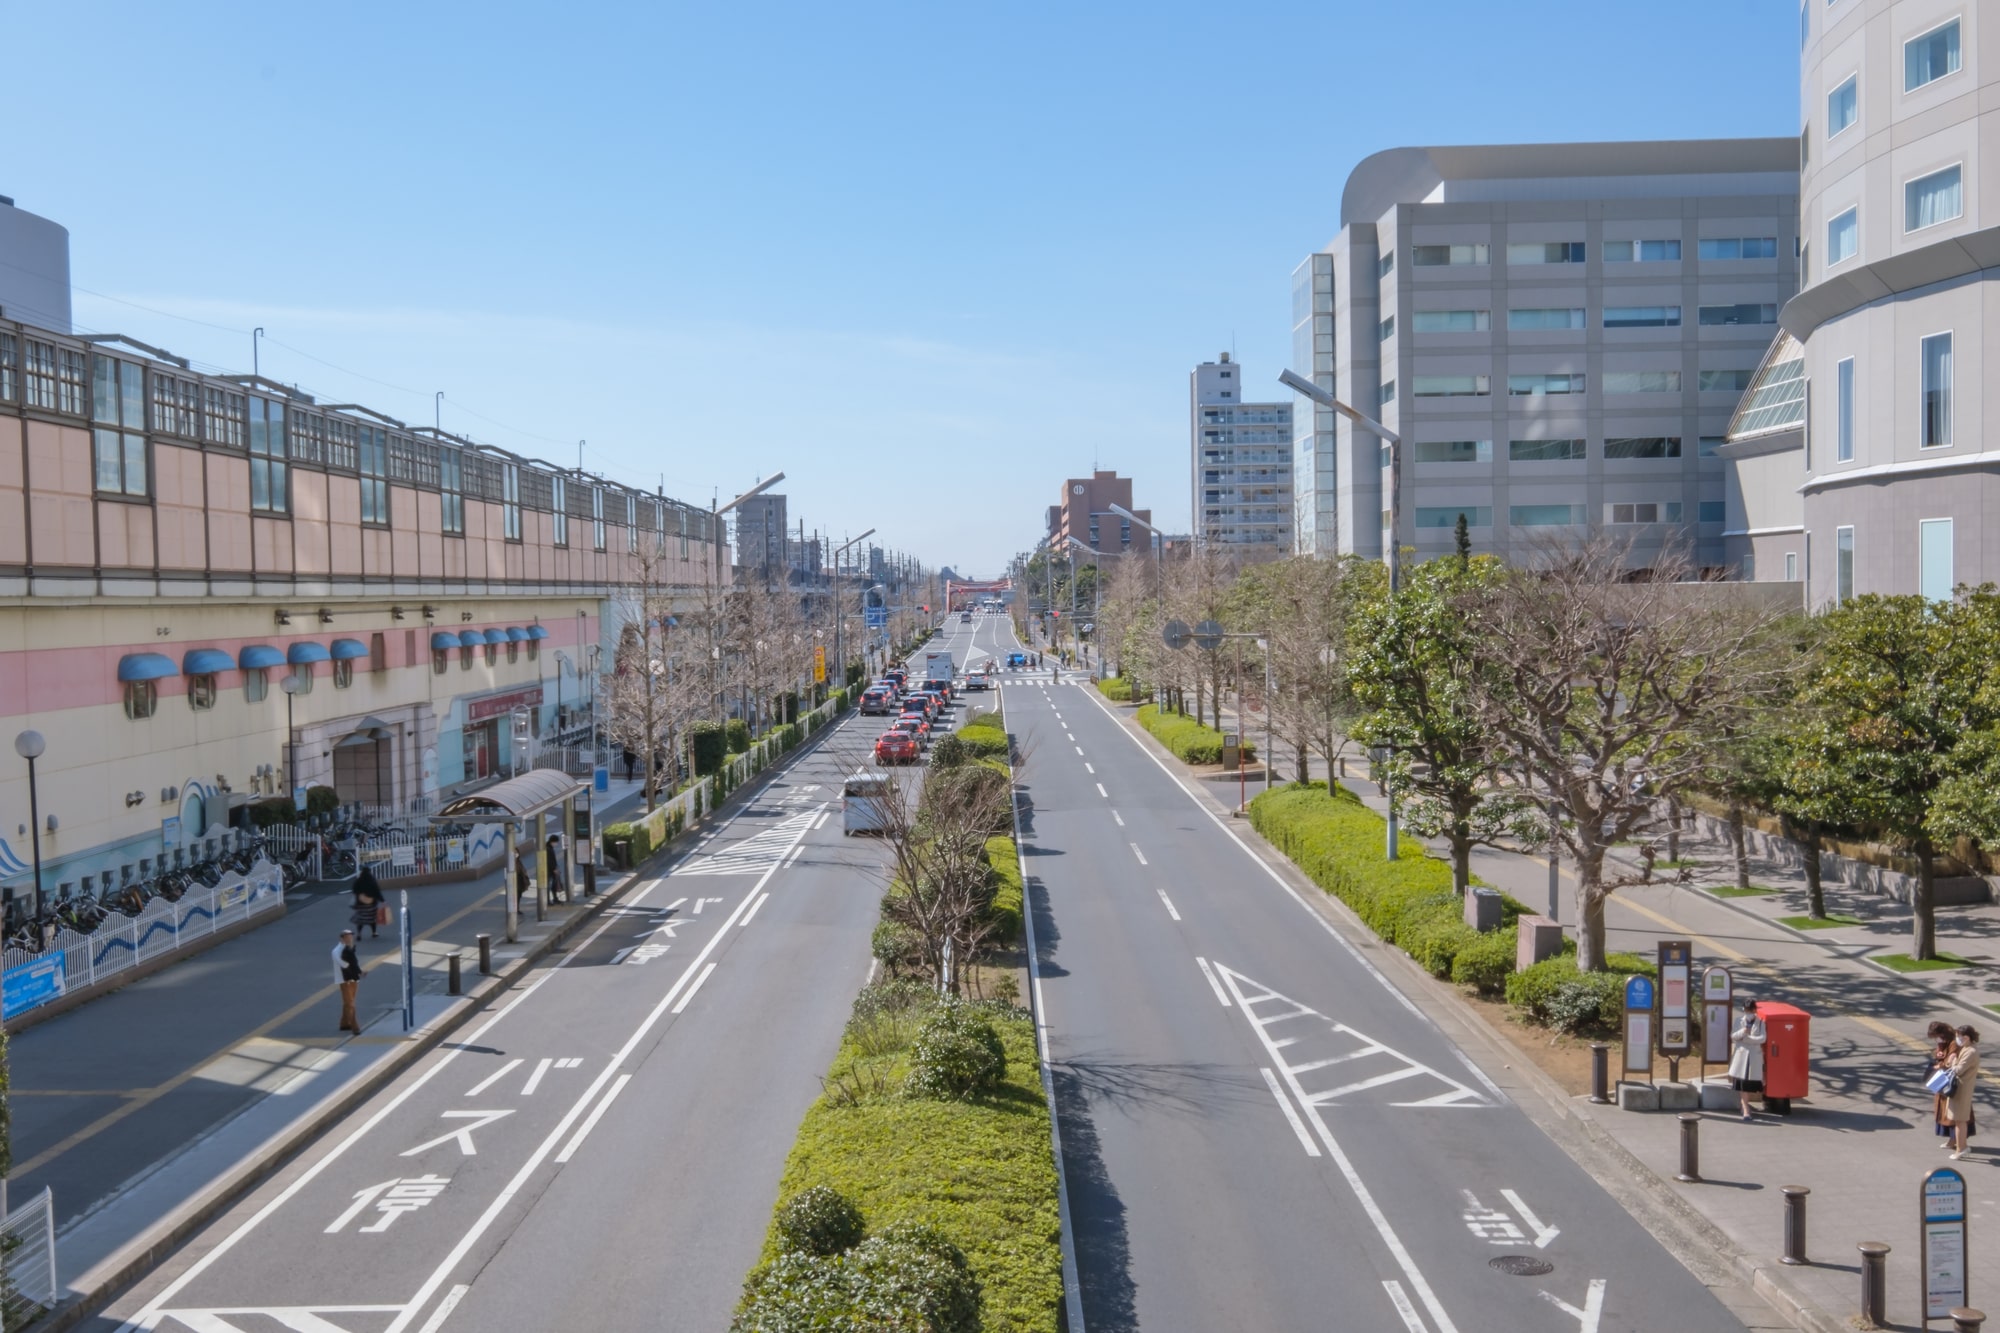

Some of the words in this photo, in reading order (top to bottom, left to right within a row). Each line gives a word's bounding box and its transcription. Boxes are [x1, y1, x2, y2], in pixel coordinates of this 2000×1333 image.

[608, 897, 723, 965] バス停
[323, 1057, 584, 1233] バス停
